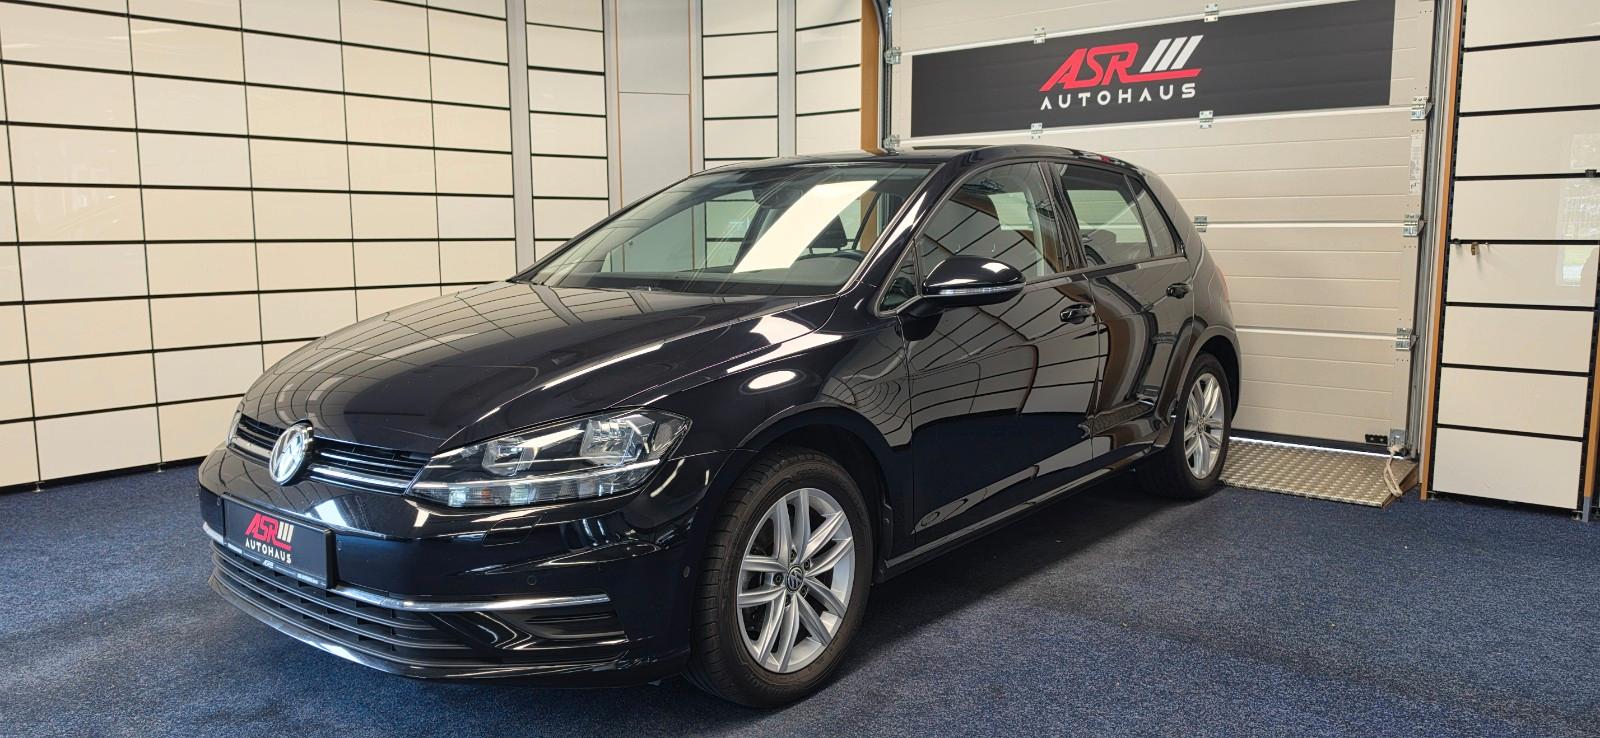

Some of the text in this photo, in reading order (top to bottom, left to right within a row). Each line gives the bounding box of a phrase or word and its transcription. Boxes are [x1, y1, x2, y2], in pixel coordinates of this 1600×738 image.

[1040, 42, 1201, 92] ASR
[1040, 83, 1196, 111] AUTOHAUS
[245, 512, 292, 551] ASR
[245, 538, 292, 564] AUTOHAUS
